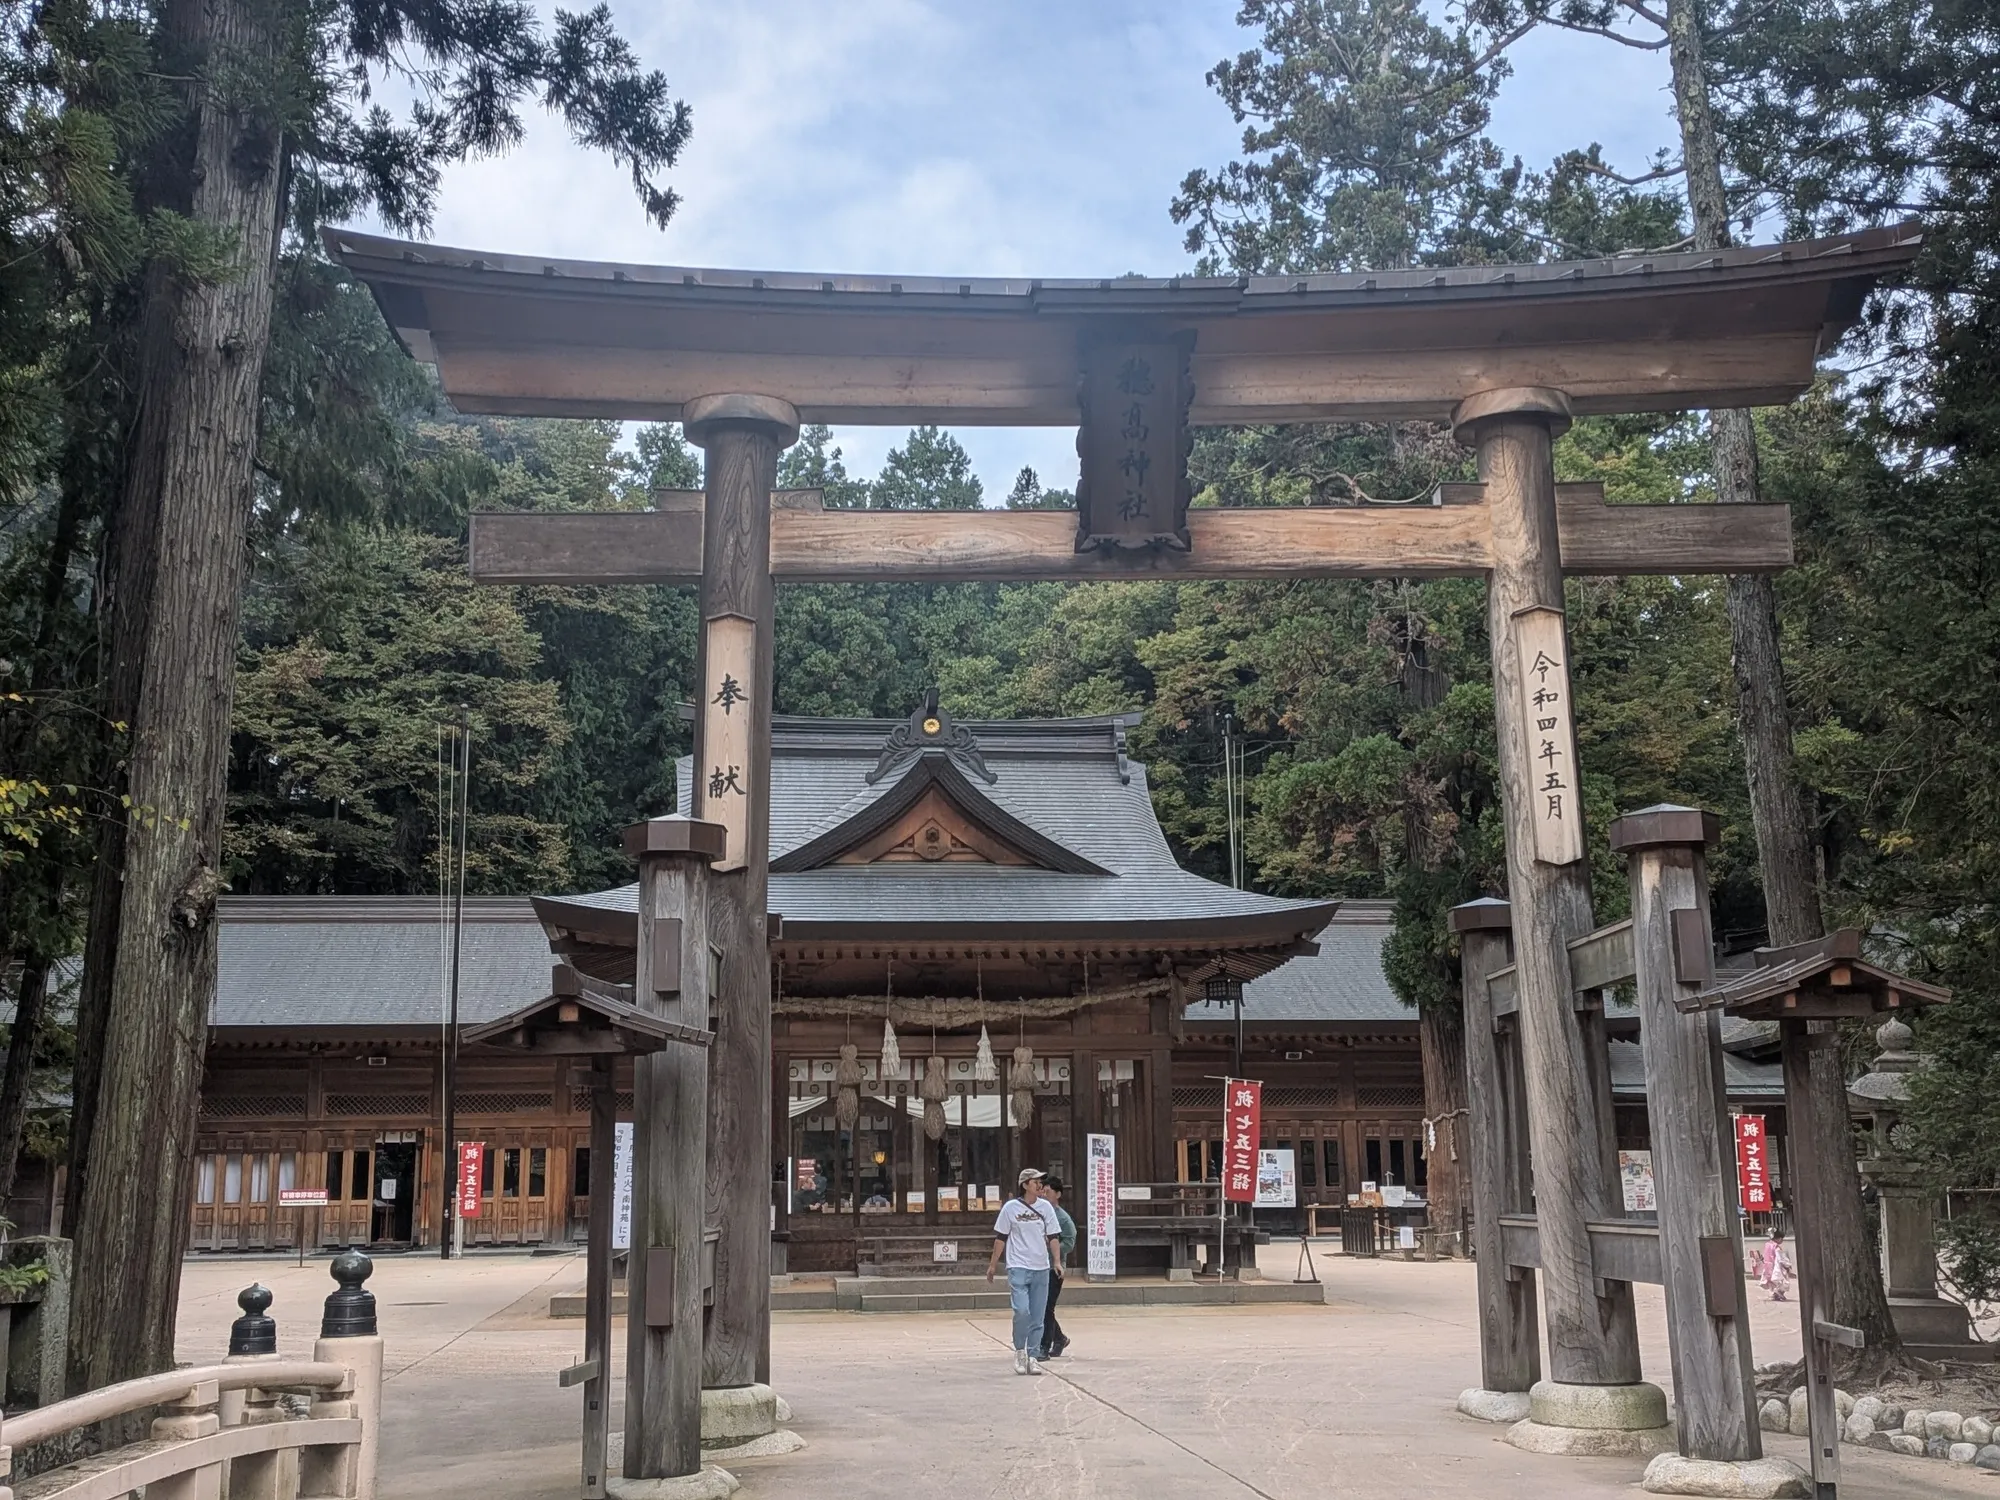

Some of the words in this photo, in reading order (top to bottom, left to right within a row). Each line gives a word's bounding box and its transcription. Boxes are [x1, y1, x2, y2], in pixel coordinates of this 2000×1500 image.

[708, 672, 749, 799] 奉献
[1529, 650, 1567, 821] 令和四年五月
